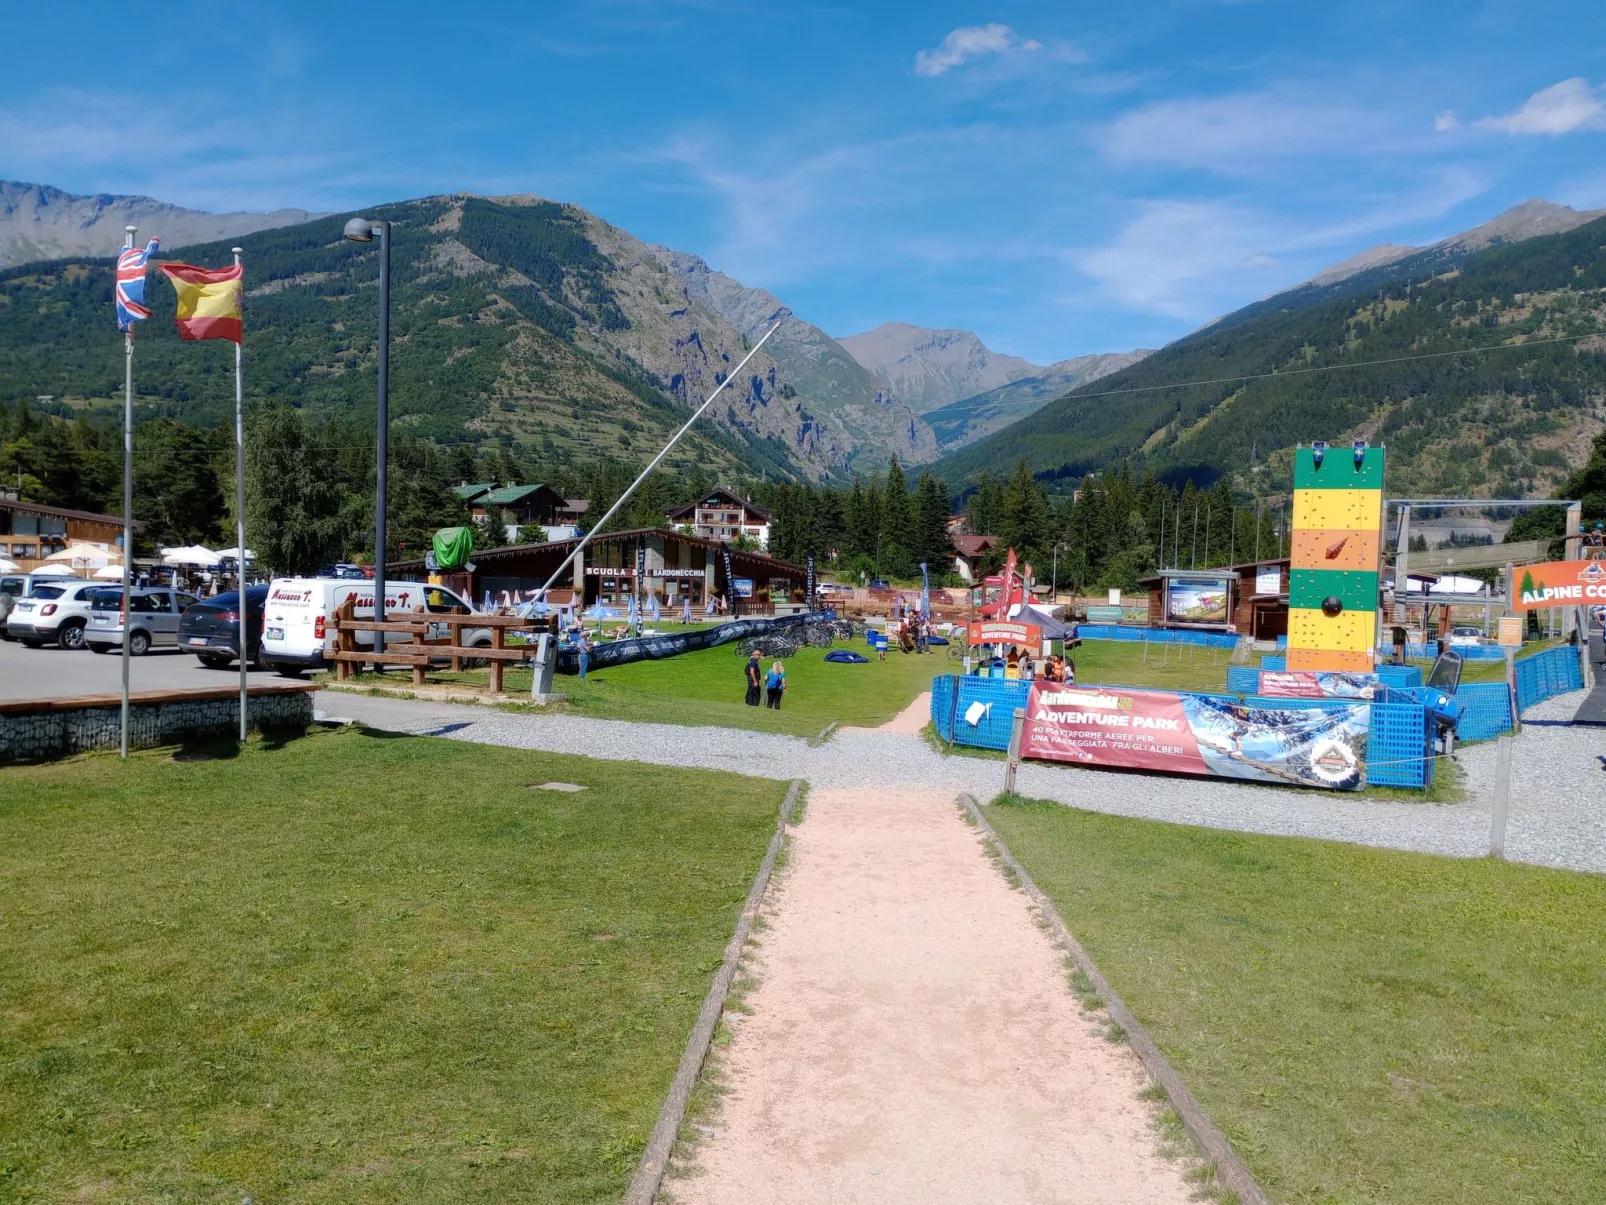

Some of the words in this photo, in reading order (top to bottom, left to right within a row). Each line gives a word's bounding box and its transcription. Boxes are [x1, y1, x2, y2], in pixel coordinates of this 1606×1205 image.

[586, 567, 626, 576] SCUOLA
[632, 568, 648, 577] SI
[653, 569, 705, 577] BARDONECCHIA
[345, 592, 397, 608] Massco
[1522, 585, 1583, 604] ALPINE
[1585, 585, 1606, 598] CO
[981, 631, 1012, 640] ADVENTURE
[1035, 709, 1130, 727] ADVENTURE
[1131, 715, 1180, 731] PARK
[1045, 727, 1102, 739] PIATTAFORME
[1104, 732, 1134, 741] AEREE
[1136, 734, 1154, 743] PER
[1031, 734, 1049, 742] UNA
[1051, 736, 1108, 748] PASSEGGIATA
[1112, 742, 1129, 750] FRA
[1149, 745, 1183, 754] ALBERI
